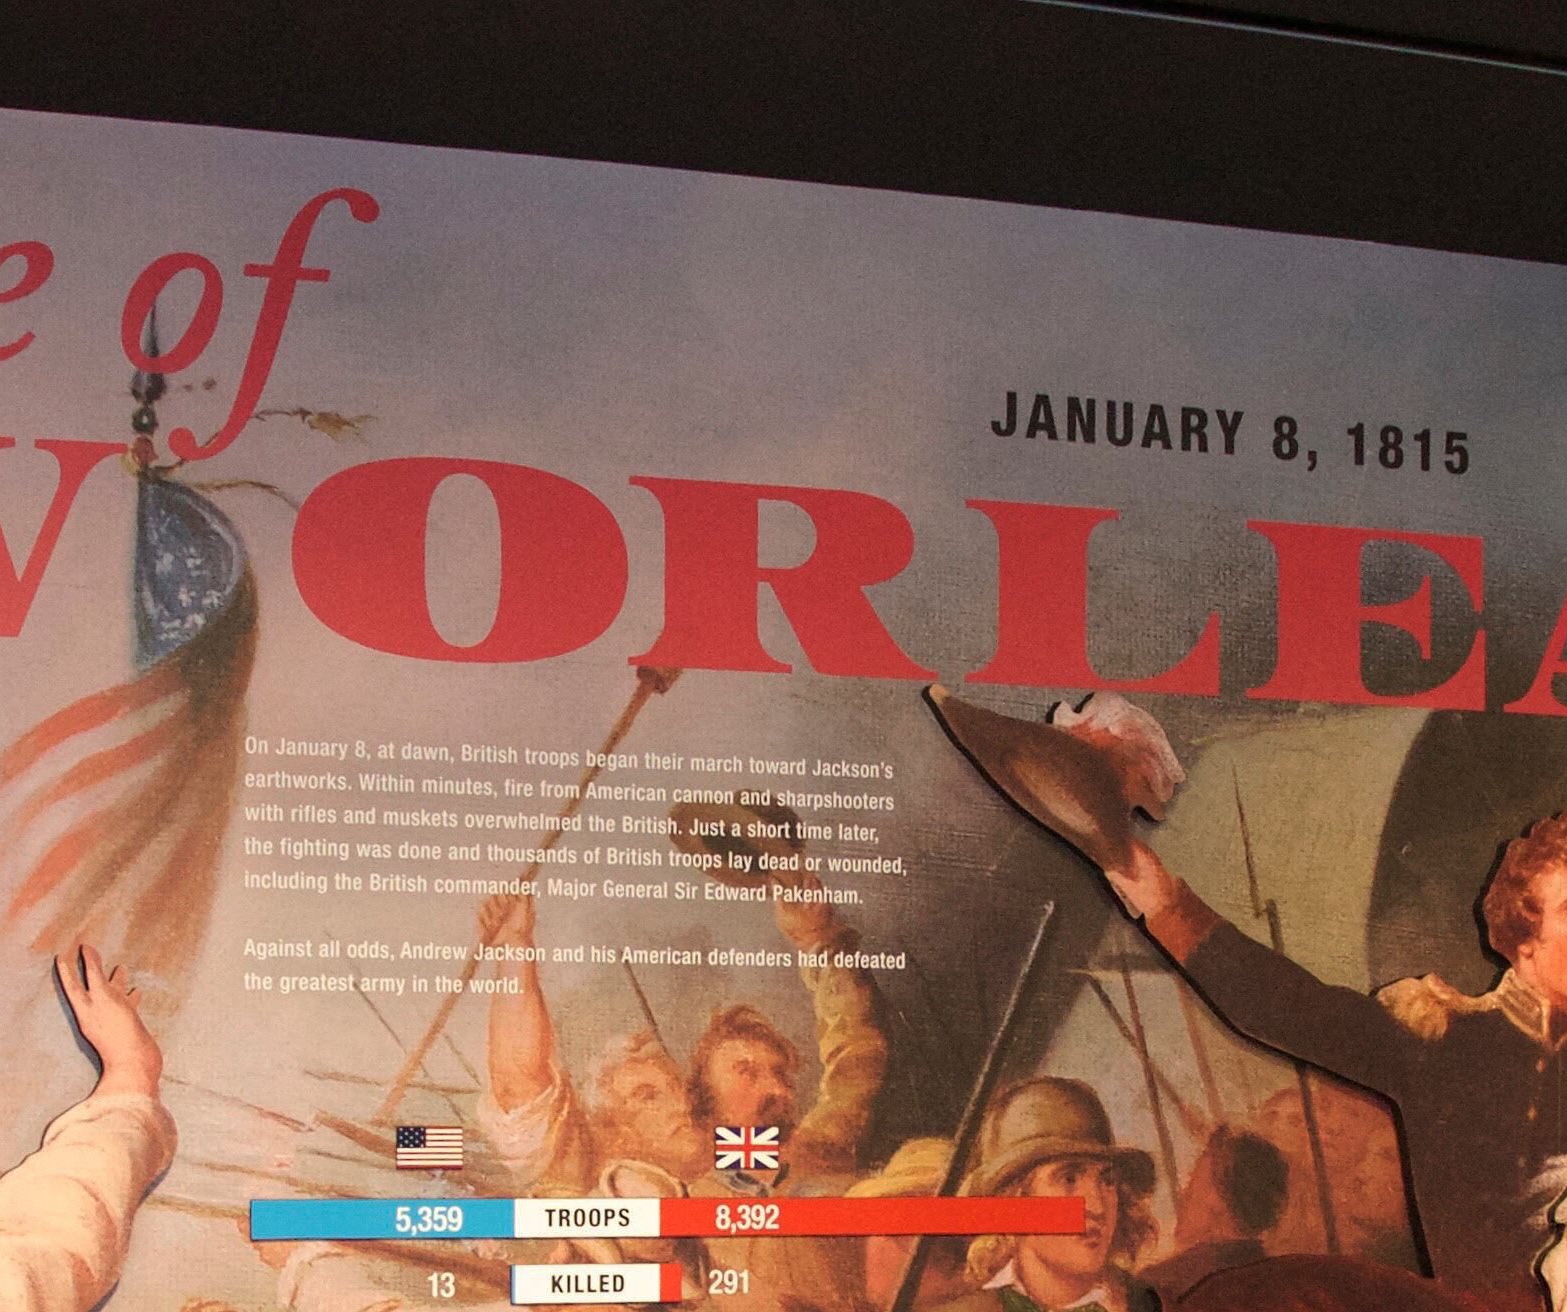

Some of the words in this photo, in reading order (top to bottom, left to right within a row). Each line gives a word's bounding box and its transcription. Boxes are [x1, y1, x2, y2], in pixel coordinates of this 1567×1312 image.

[122, 190, 377, 460] of
[990, 390, 1245, 456] JANUARY
[1272, 415, 1319, 473] 8,
[1346, 421, 1471, 477] 1815
[245, 735, 268, 754] On
[275, 737, 348, 761] January
[354, 740, 371, 760] 8,
[377, 742, 395, 759] at
[401, 742, 455, 764] dawn,
[461, 744, 518, 764] British
[524, 747, 580, 769] troops
[585, 749, 638, 772] began
[644, 752, 684, 771] their
[690, 756, 743, 773] march
[748, 756, 807, 776] toward
[811, 758, 894, 780] Jackson's
[245, 771, 352, 791] earthworks.
[359, 773, 415, 793] Within
[422, 776, 498, 797] minutes,
[504, 778, 533, 797] fire
[540, 780, 580, 799] from
[585, 782, 667, 802] American
[672, 788, 734, 805] cannon
[739, 788, 771, 807] and
[777, 789, 895, 812] sharpshooters
[244, 803, 284, 822] with
[290, 804, 337, 824] rifles
[343, 807, 376, 825] and
[383, 808, 458, 828] muskets
[464, 811, 582, 832] overwhelmed
[587, 814, 616, 833] the
[621, 815, 683, 836] British.
[688, 817, 726, 838] Just
[730, 821, 742, 838] a
[746, 819, 792, 840] short
[795, 820, 833, 841] time
[838, 822, 880, 844] later,
[244, 836, 273, 855] the
[279, 837, 350, 861] fighting
[356, 843, 392, 859] was
[398, 841, 442, 860] done
[448, 843, 481, 861] and
[487, 844, 578, 864] thousands
[583, 846, 601, 865] of
[606, 846, 663, 867] British
[668, 849, 724, 872] troops
[727, 850, 754, 874] lay
[757, 851, 802, 872] dead
[803, 855, 824, 872] or
[827, 852, 908, 877] wounded,
[244, 870, 328, 894] including
[334, 872, 362, 891] the
[369, 873, 427, 892] British
[434, 877, 542, 900] commander,
[547, 877, 597, 901] Major
[602, 879, 668, 899] General
[674, 881, 699, 900] Sir
[704, 881, 767, 902] Edward
[770, 884, 864, 906] Pakenham.
[243, 938, 313, 961] Against
[318, 939, 342, 959] all
[346, 940, 395, 961] odds,
[399, 941, 468, 960] Andrew
[473, 939, 546, 962] Jackson
[552, 945, 584, 963] and
[590, 944, 617, 964] his
[620, 945, 702, 966] American
[706, 947, 793, 968] defenders
[797, 948, 830, 968] had
[833, 949, 908, 971] defeated
[244, 972, 273, 991] the
[279, 973, 355, 995] greatest
[359, 976, 406, 997] army
[412, 974, 428, 993] in
[434, 975, 464, 994] the
[469, 976, 524, 995] world.
[395, 1205, 464, 1238] 5,359
[544, 1207, 632, 1229] TROOPS
[715, 1203, 781, 1236] 8,392
[427, 1271, 457, 1300] 13
[550, 1273, 626, 1295] KILLED
[707, 1267, 750, 1296] 291
